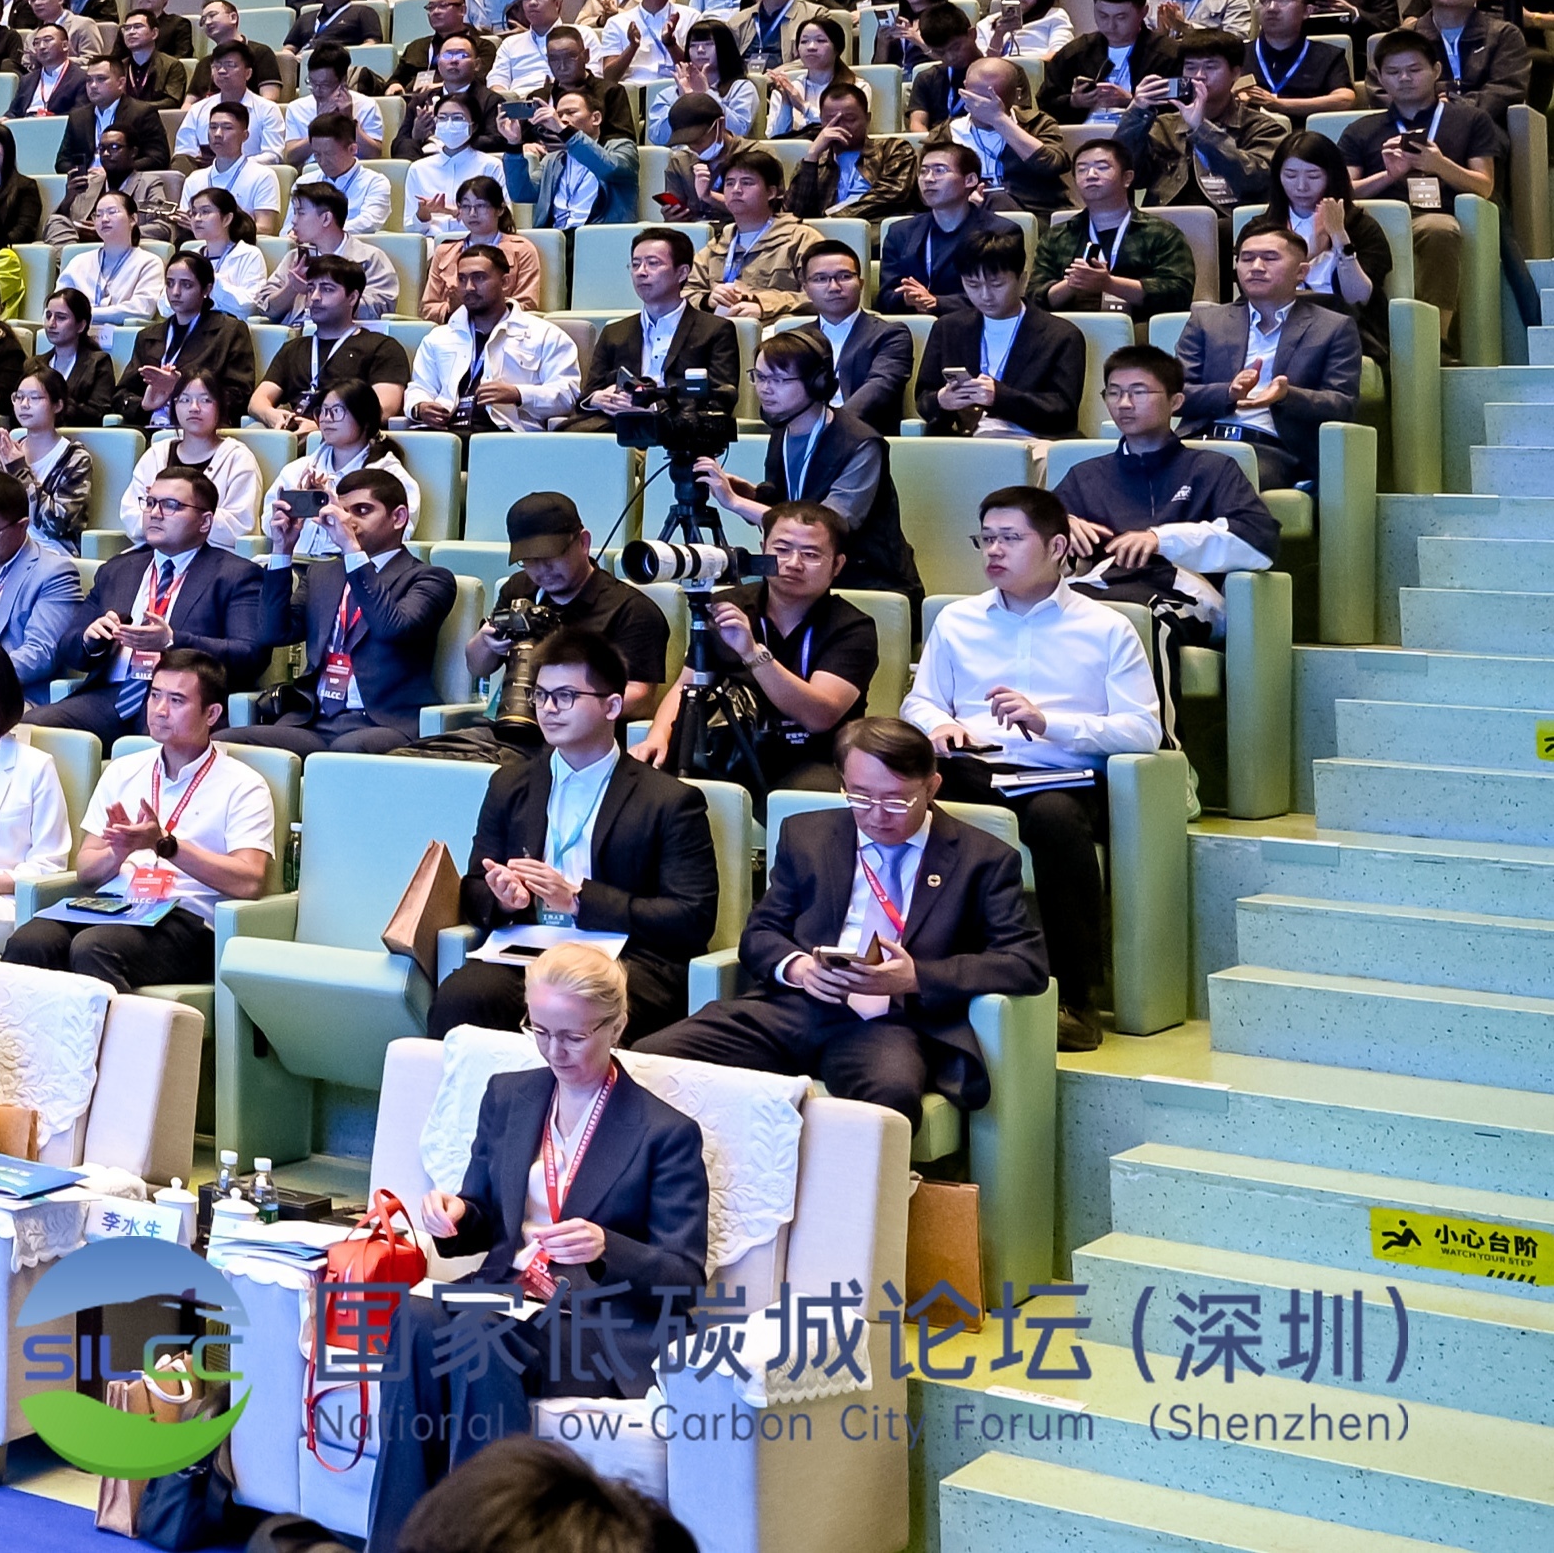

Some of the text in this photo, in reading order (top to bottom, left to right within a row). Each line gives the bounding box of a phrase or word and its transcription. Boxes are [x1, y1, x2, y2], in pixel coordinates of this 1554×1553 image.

[1434, 1224, 1538, 1259] 小心台阶
[1441, 1247, 1533, 1267] WATCH YOUR STEP
